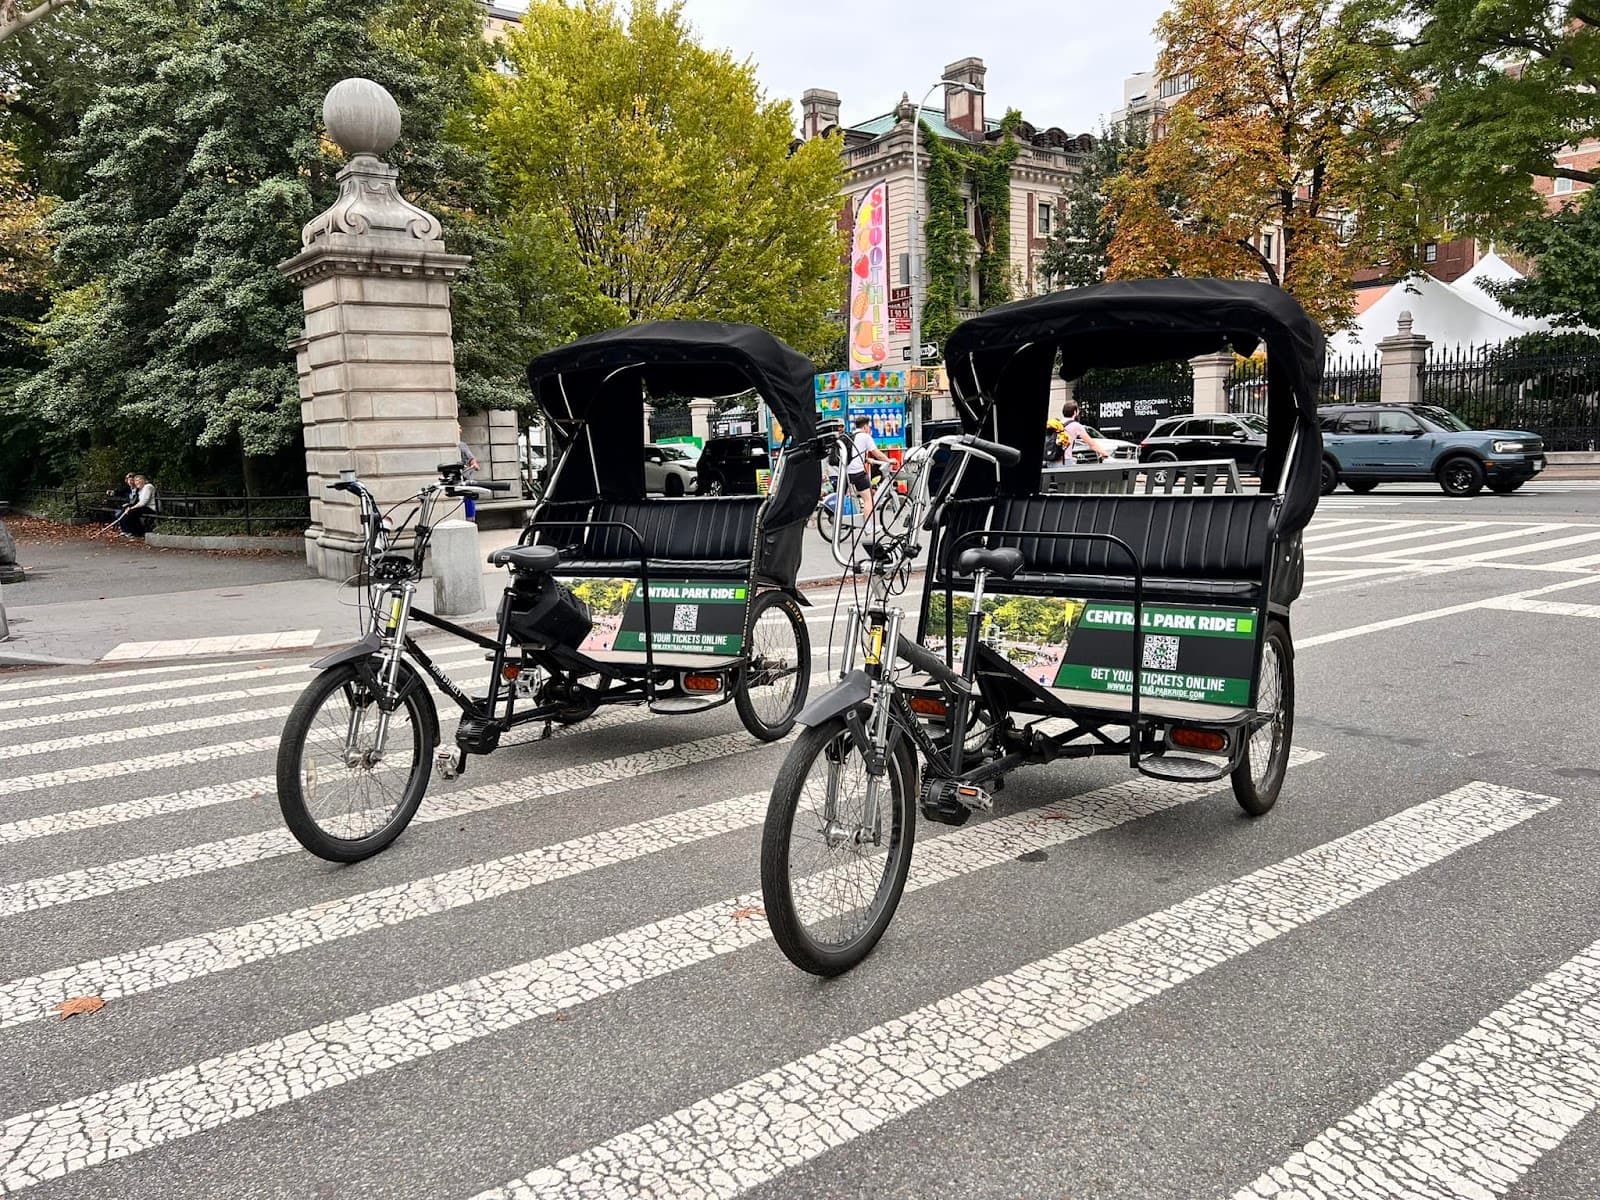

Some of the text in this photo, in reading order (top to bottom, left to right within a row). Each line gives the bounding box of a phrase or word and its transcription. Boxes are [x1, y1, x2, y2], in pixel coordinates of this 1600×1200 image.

[869, 187, 886, 362] SMOOTHIES
[1100, 401, 1131, 410] MAKING
[1100, 409, 1124, 418] HOME
[636, 586, 735, 600] CNTRAL PARK RIDE
[1086, 610, 1236, 632] CENTRL PARK RIDE
[653, 632, 671, 643] YOUR
[672, 633, 701, 644] TICKETS
[701, 635, 728, 645] ONLINE
[1090, 668, 1226, 692] GET YOU TICKETS ONLINE
